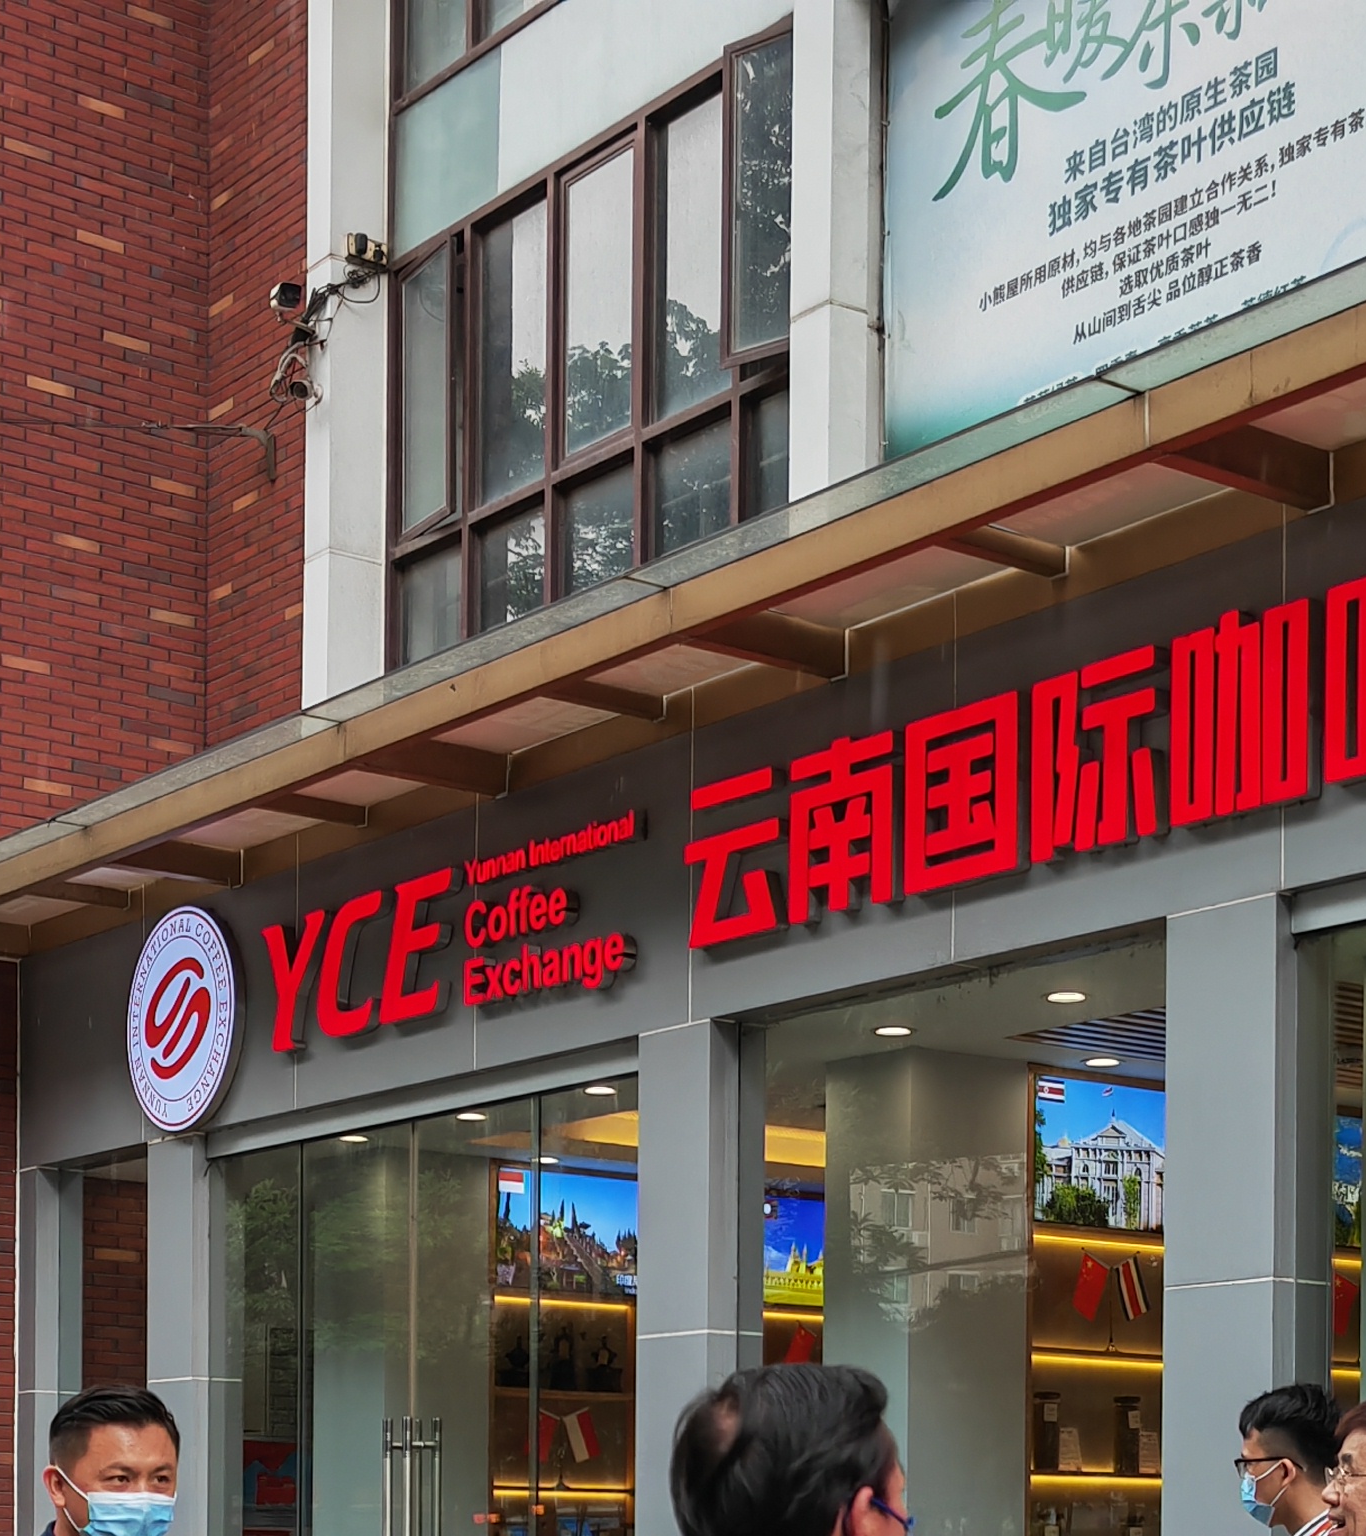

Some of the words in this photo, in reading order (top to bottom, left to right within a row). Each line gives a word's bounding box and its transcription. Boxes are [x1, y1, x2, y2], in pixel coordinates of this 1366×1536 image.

[1064, 47, 1278, 183] 来自台湾的原生茶园
[1048, 81, 1296, 237] 独家专有茶叶供应链
[1118, 238, 1212, 298] 选取优质茶叶
[464, 848, 526, 885] Yunnan
[529, 809, 634, 867] International
[464, 884, 568, 949] Coffee
[132, 918, 192, 1048] INTERNATIONAL
[195, 923, 228, 992] COFFEE
[261, 867, 453, 1052] YCE
[464, 932, 625, 1006] Exchange
[135, 1057, 169, 1118] YUNNAN
[187, 1000, 228, 1113] EXCHANGE
